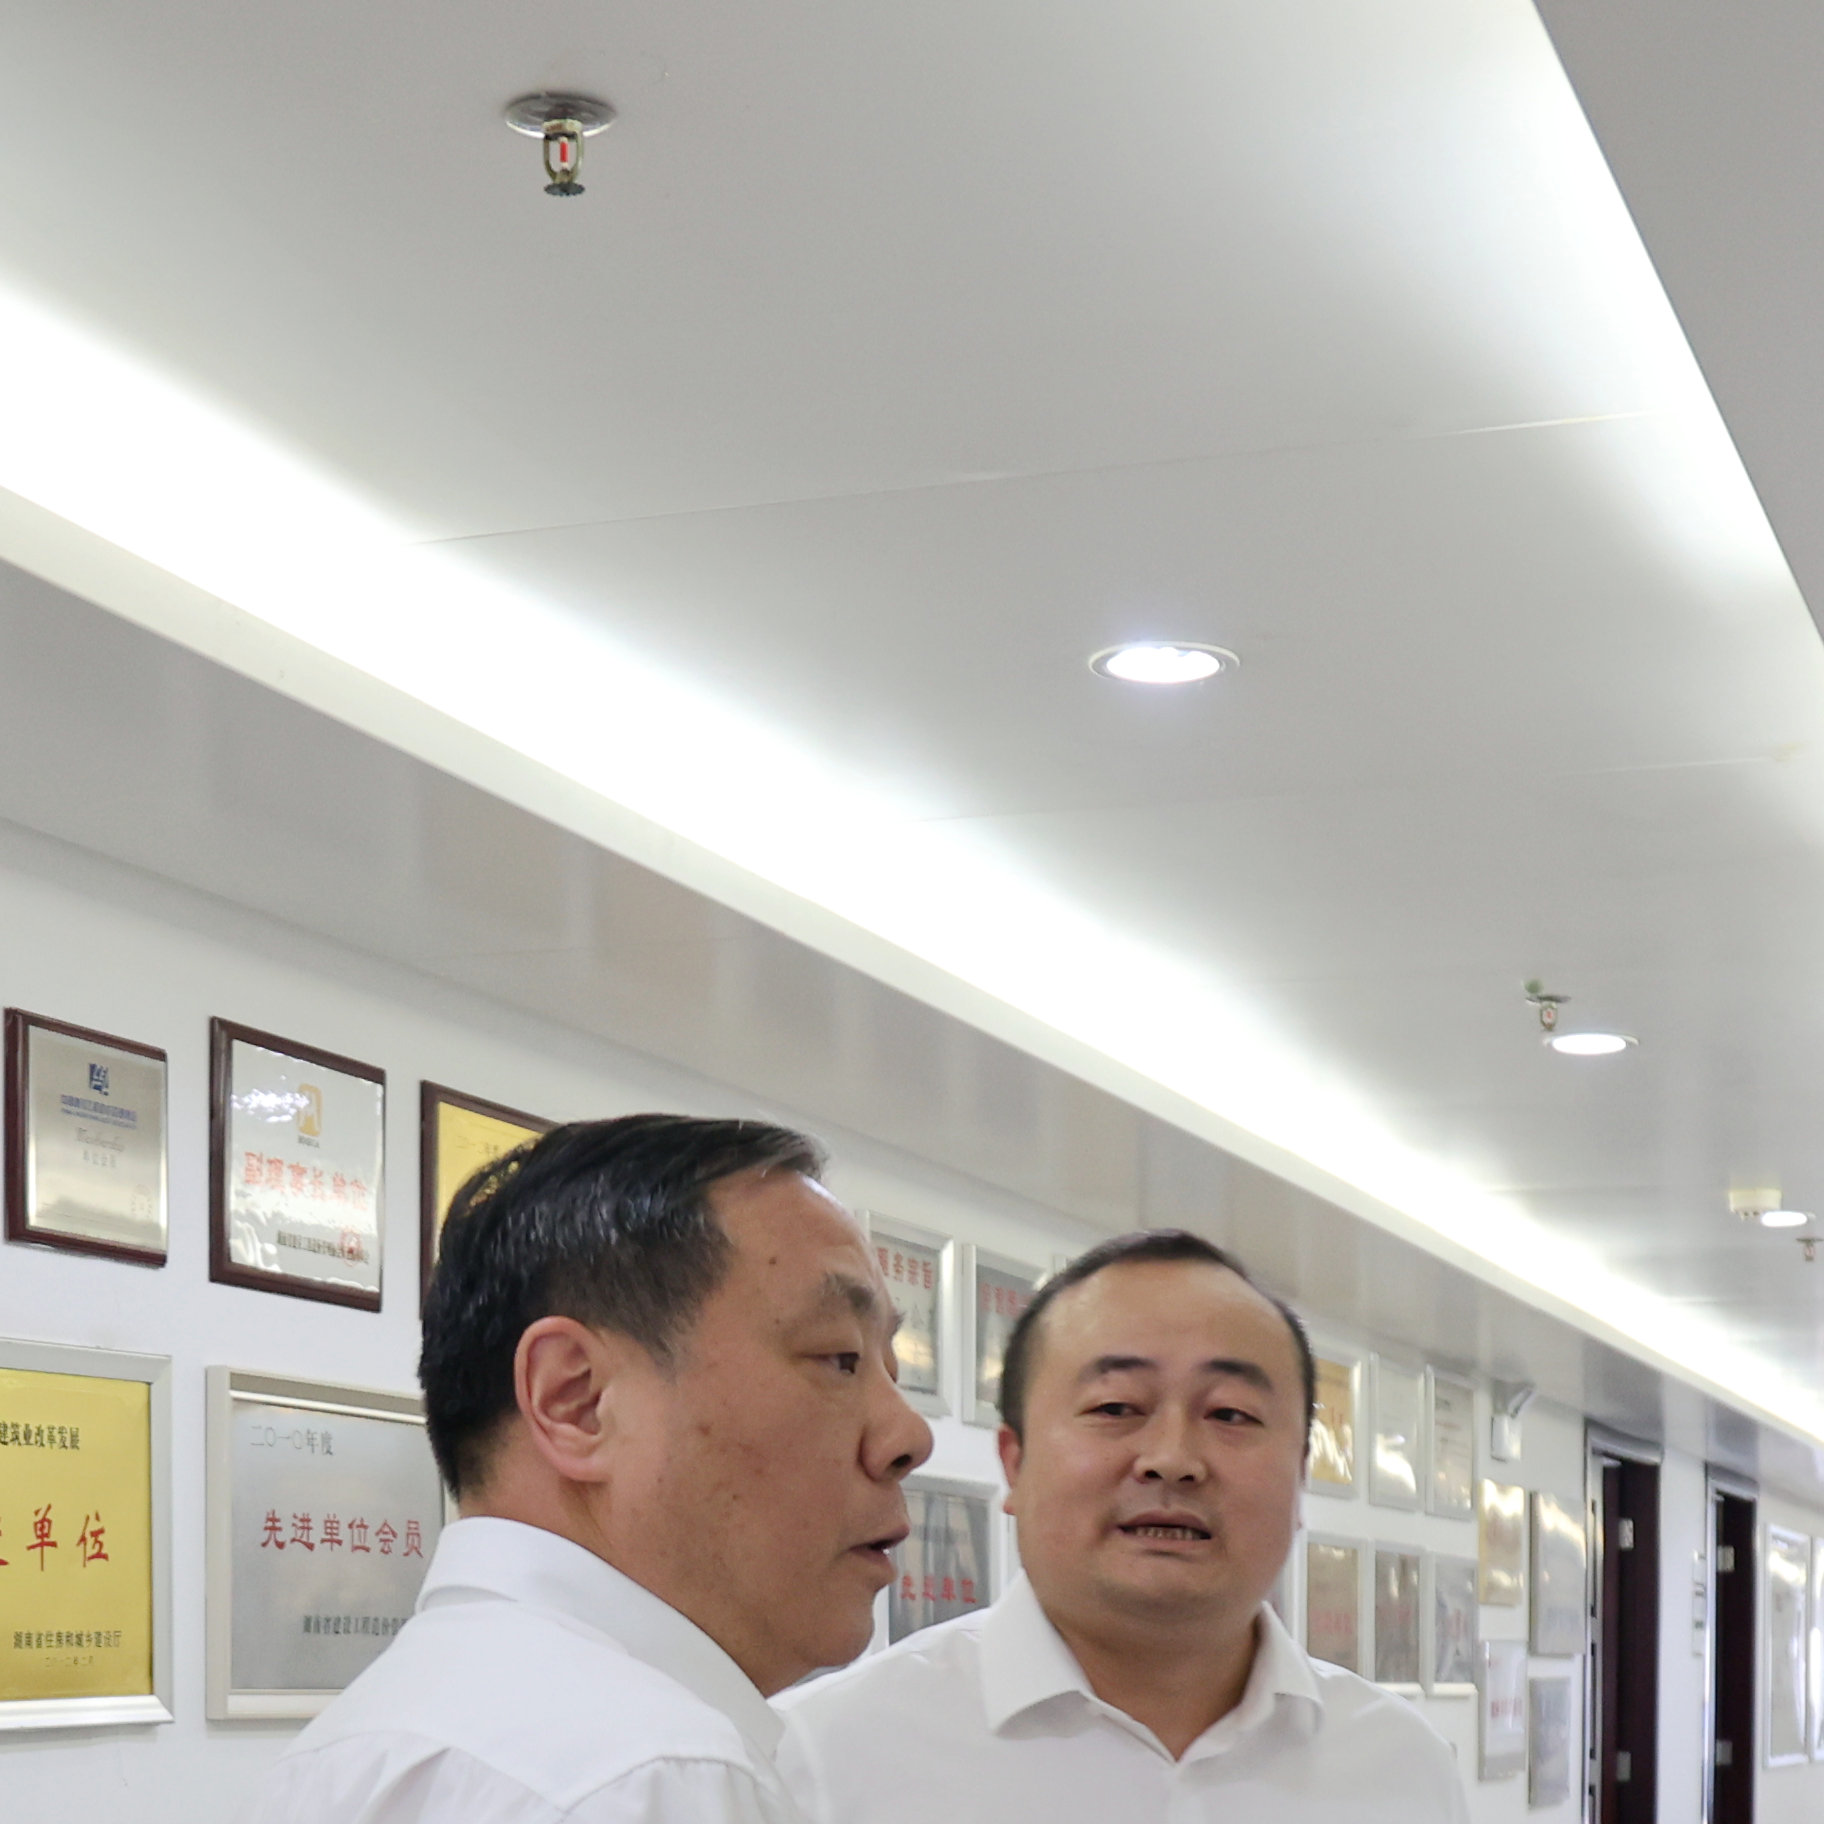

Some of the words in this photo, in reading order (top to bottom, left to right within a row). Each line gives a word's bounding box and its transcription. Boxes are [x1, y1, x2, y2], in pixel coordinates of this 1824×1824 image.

[261, 1510, 425, 1560] 先进单位会员
